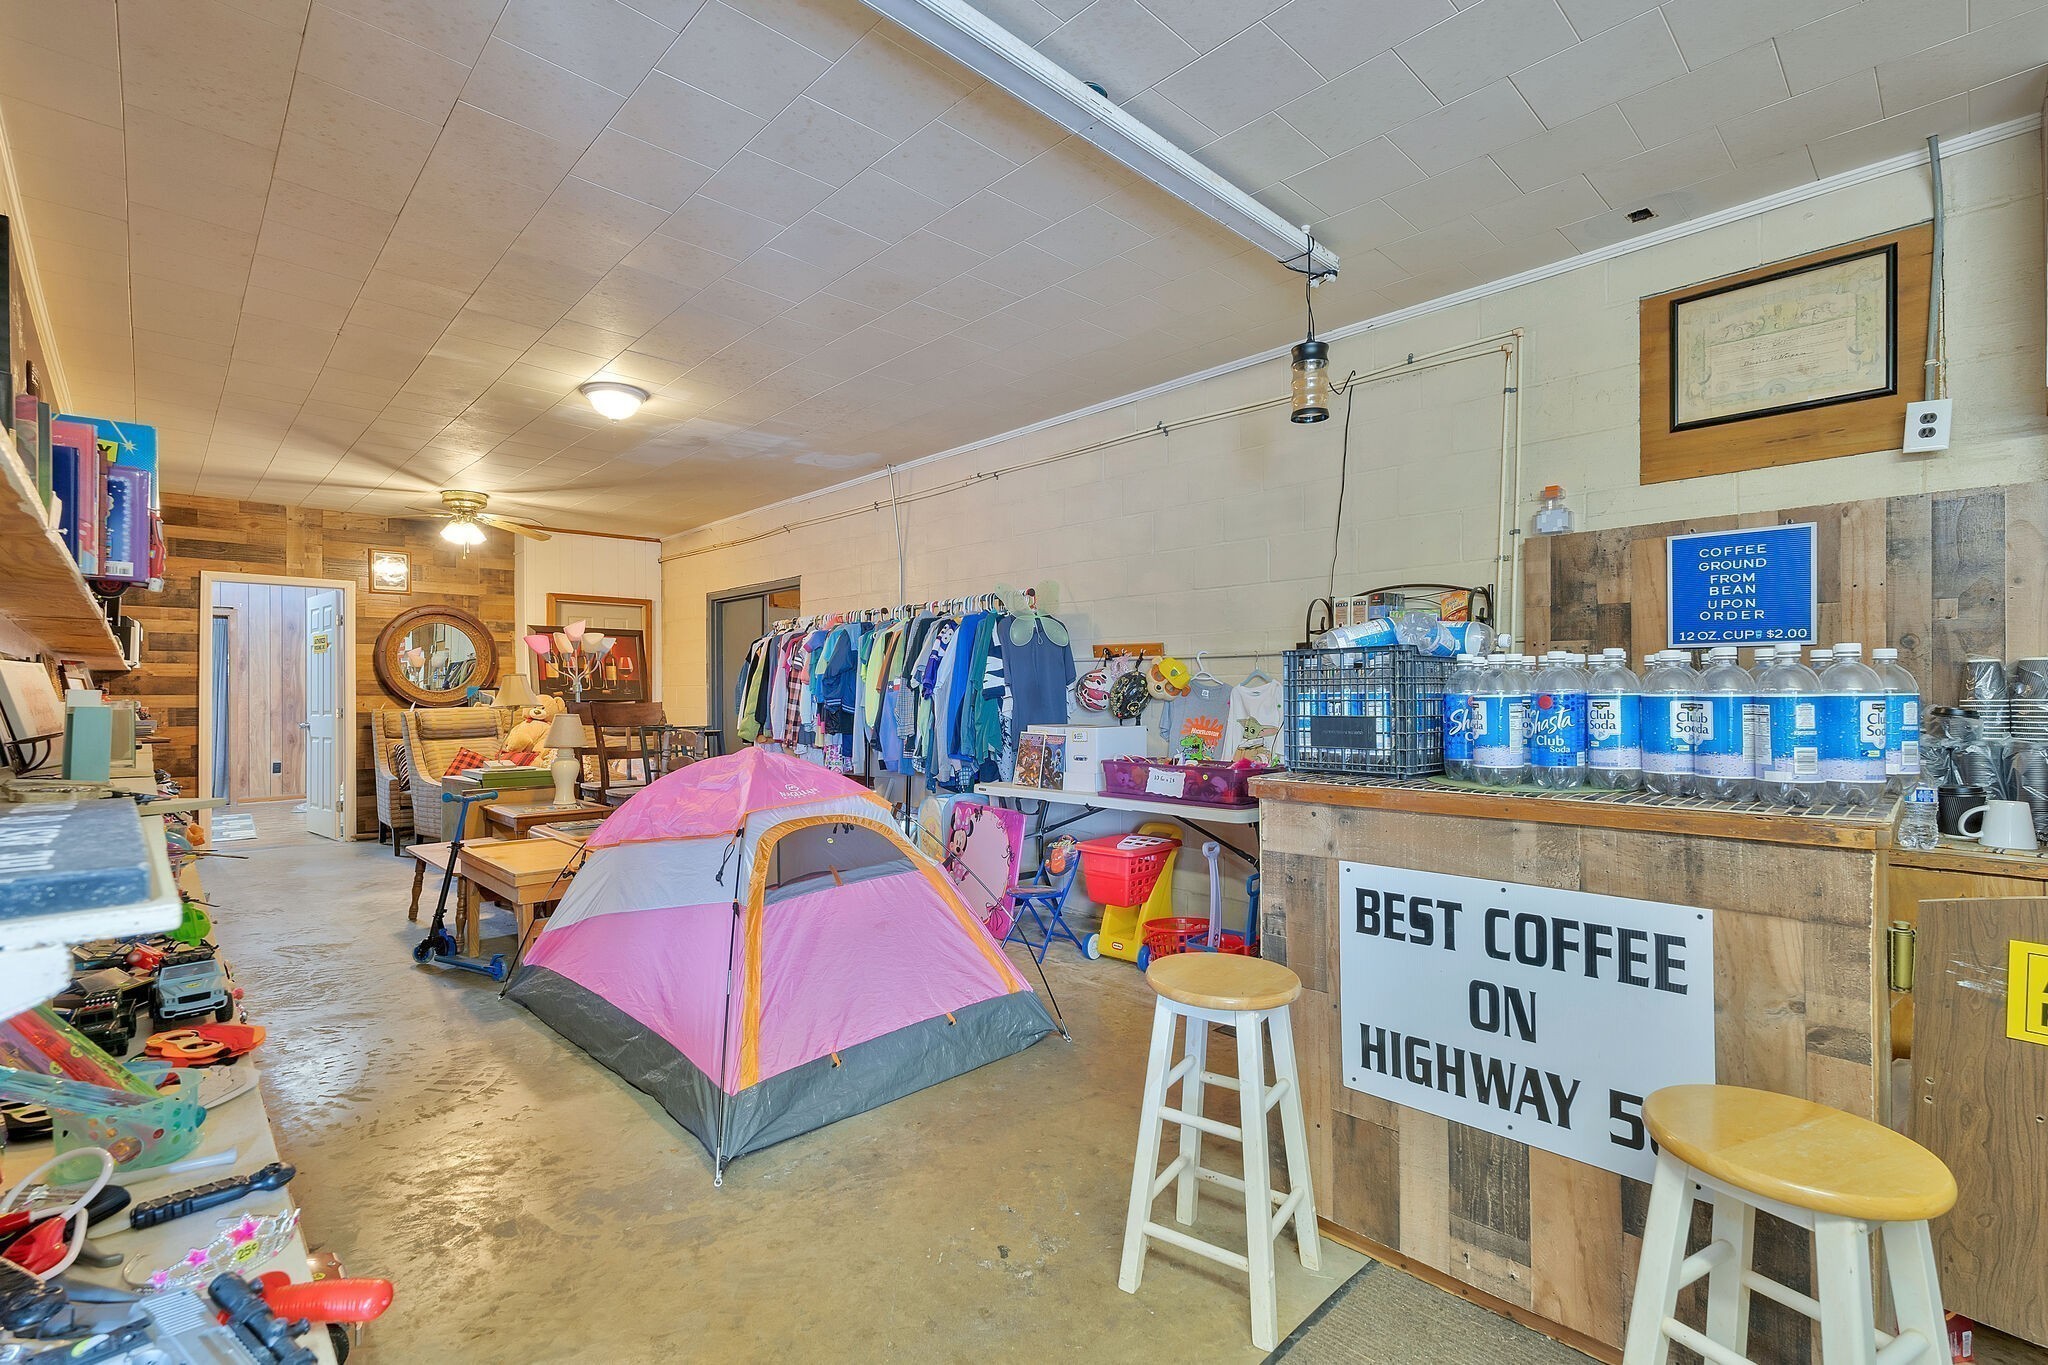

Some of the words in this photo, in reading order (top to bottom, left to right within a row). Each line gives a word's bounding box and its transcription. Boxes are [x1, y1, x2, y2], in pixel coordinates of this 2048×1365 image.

[1698, 544, 1767, 558] COFFEE
[1698, 558, 1767, 571] GROUND
[1710, 573, 1755, 584] FROM
[1709, 585, 1756, 596] BEAN
[1708, 598, 1756, 609] UPON
[1699, 609, 1765, 621] ORDER
[1679, 631, 1695, 641] 12
[1697, 630, 1721, 641] OZ.
[1723, 630, 1754, 640] CUP
[1766, 628, 1808, 639] $2.00
[1529, 706, 1575, 736] Shasta
[1590, 710, 1615, 720] Club
[1867, 713, 1886, 725] Clu
[1590, 720, 1617, 730] Soda
[1536, 735, 1565, 746] Club
[1355, 887, 1463, 951] BEST
[1484, 907, 1688, 995] COFFEE
[1468, 979, 1537, 1043] ON
[1360, 1022, 1581, 1130] HIGHWAY
[1609, 1089, 1659, 1156] 5
